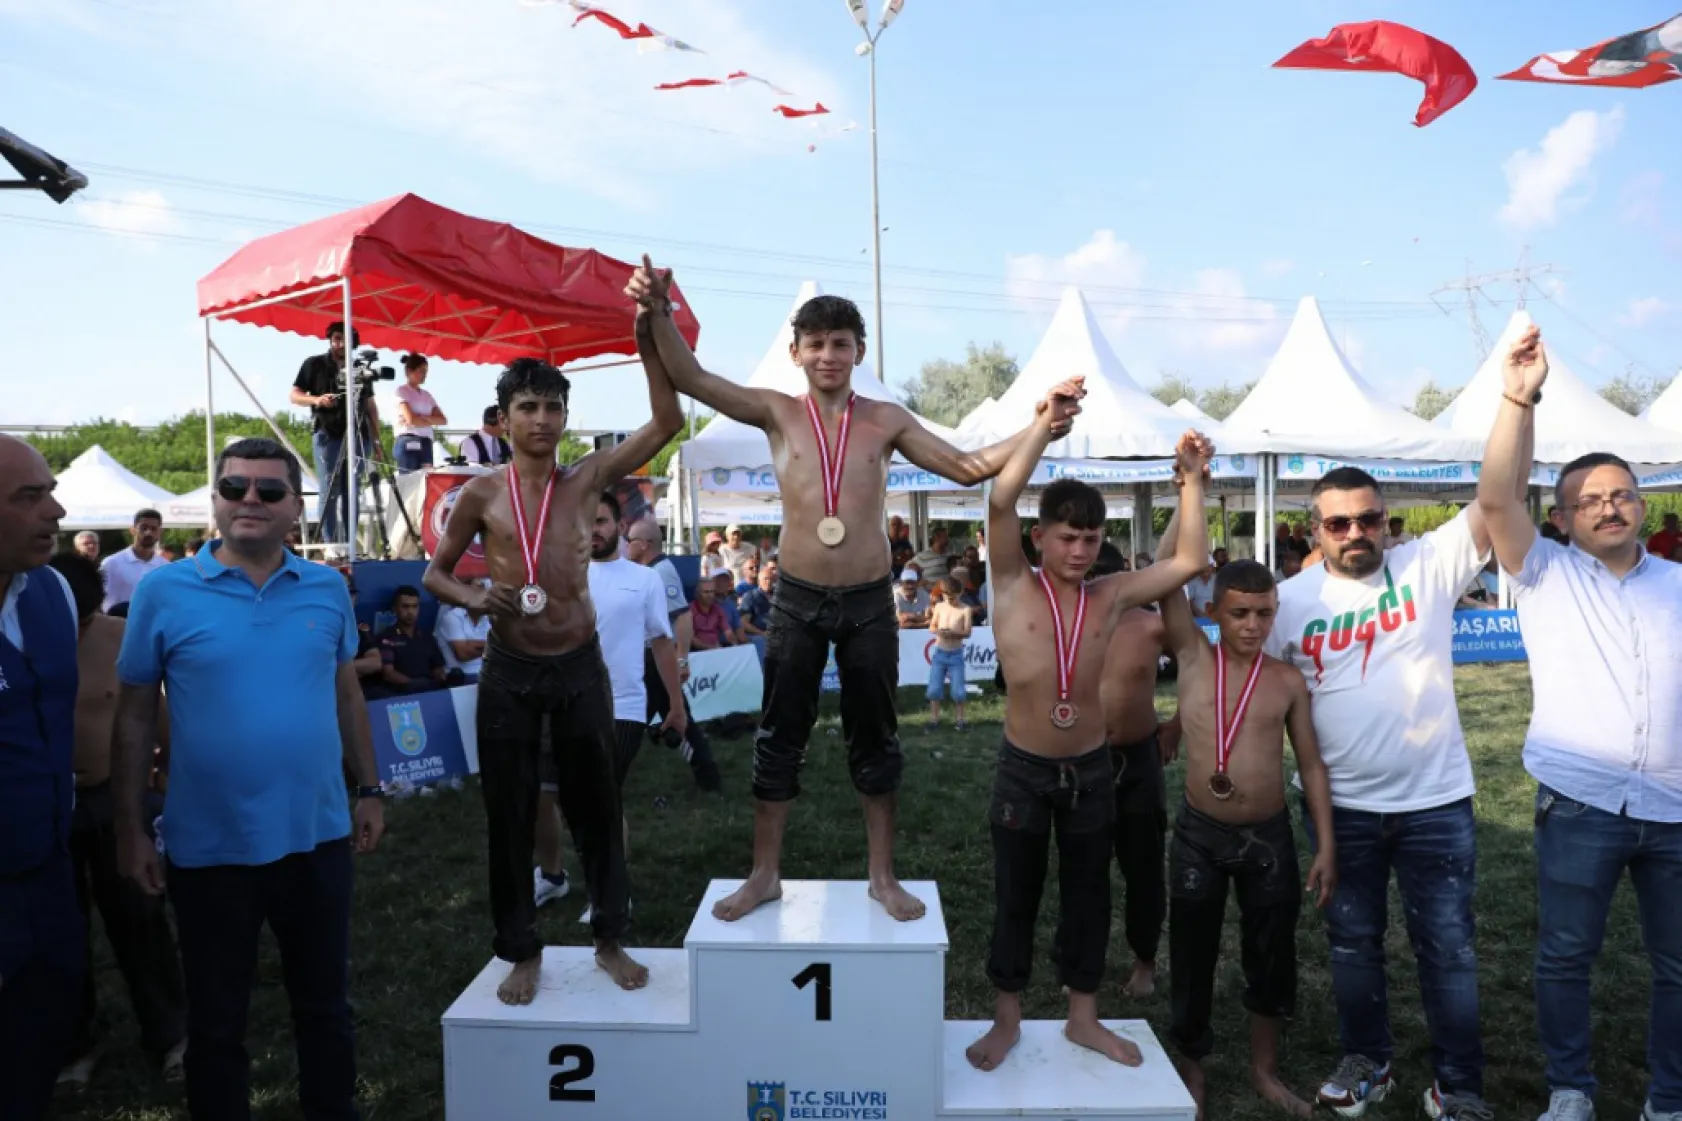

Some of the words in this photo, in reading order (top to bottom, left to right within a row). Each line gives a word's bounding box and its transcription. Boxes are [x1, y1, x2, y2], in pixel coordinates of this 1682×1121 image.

[791, 961, 832, 1021] 1
[548, 1043, 595, 1102] 2
[789, 1090, 820, 1106] T.C.
[823, 1090, 887, 1106] SİLİVRİ
